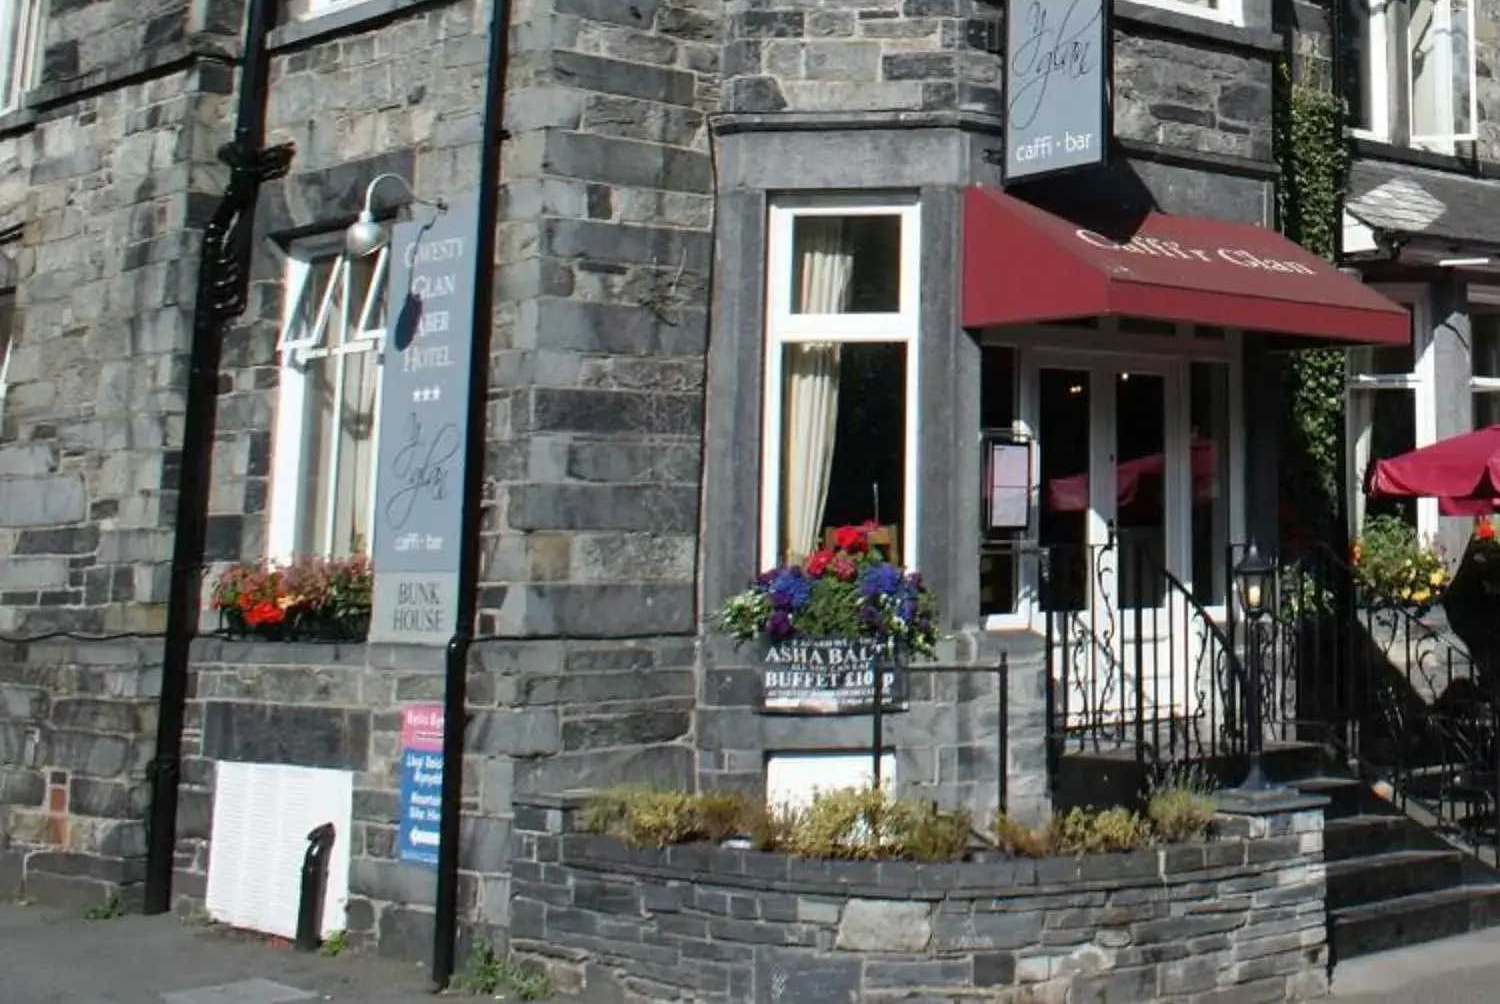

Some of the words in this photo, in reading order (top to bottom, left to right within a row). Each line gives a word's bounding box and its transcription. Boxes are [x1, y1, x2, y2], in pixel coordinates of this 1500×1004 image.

[1016, 135, 1053, 162] caffi
[1064, 131, 1093, 154] bar
[1217, 247, 1319, 276] Glan
[411, 274, 457, 301] GLAN
[403, 345, 453, 373] HOTEL
[397, 583, 442, 606] BUNK
[392, 608, 445, 633] HOUSE
[764, 646, 824, 665] ASHA
[765, 669, 839, 688] BUFFET
